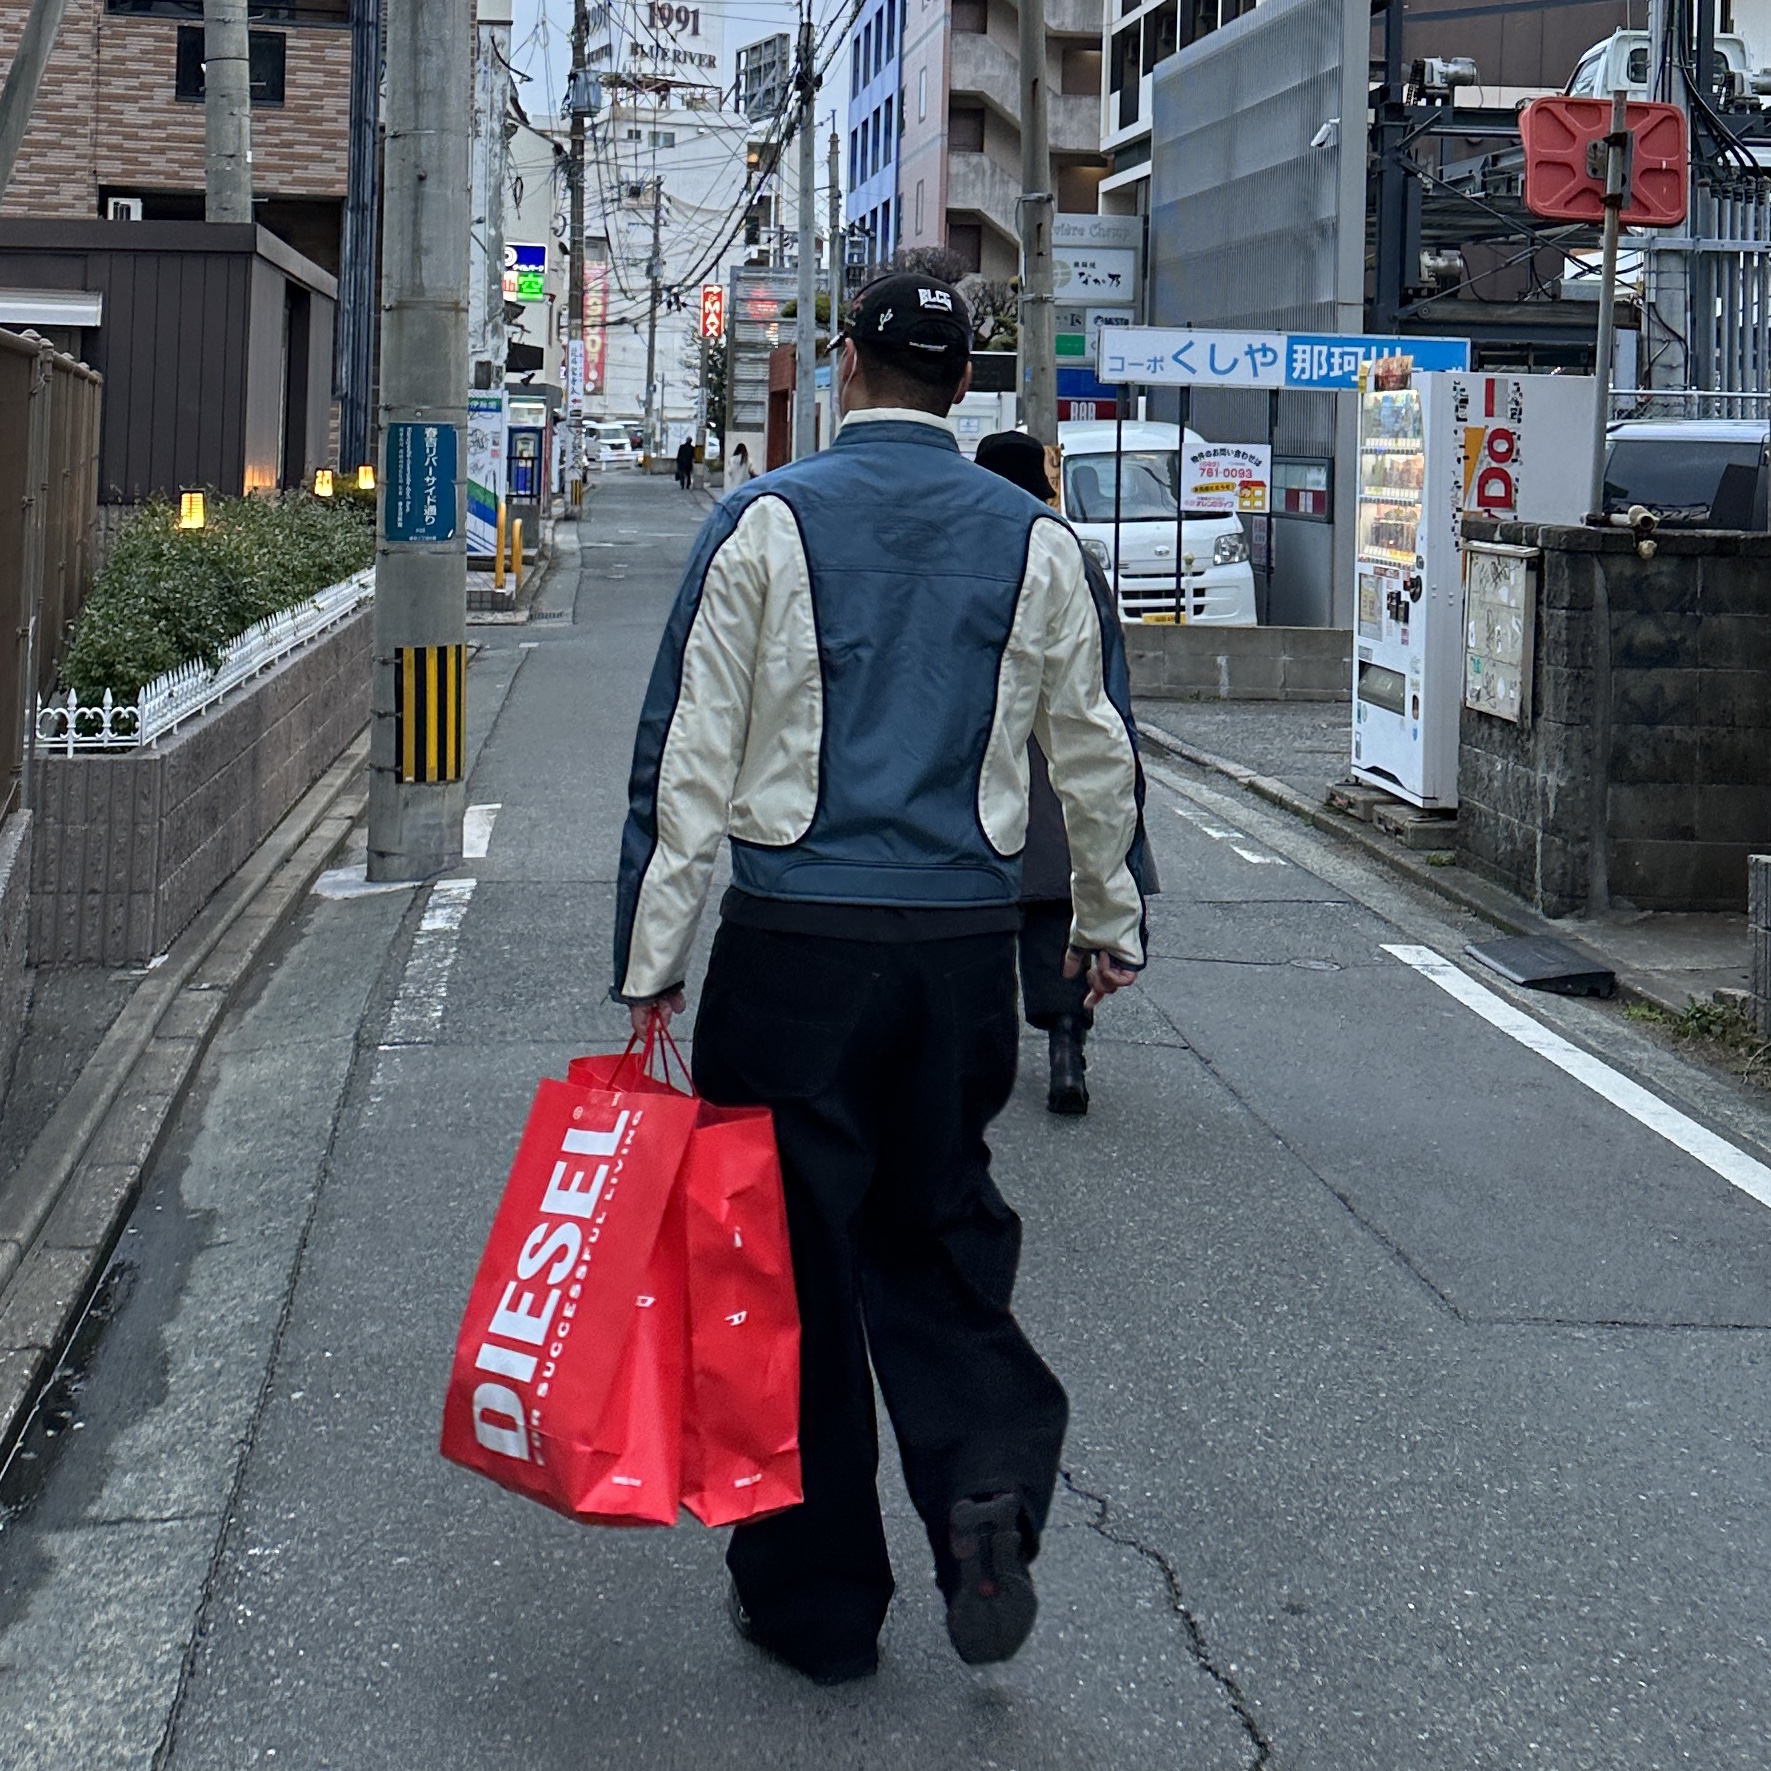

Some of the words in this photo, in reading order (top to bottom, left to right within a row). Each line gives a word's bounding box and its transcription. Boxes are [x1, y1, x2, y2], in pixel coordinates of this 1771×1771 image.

[647, 1, 701, 36] 1991
[673, 48, 717, 68] RIVER
[704, 300, 720, 337] MAX
[424, 427, 438, 526] 春吉リバーサイド通り
[1190, 448, 1263, 467] 物件のお問い合わせは
[1477, 427, 1515, 519] Do
[472, 1109, 631, 1463] DIESEL
[536, 1211, 607, 1398] SUCCESSFUL
[603, 1110, 643, 1201] LIVING
